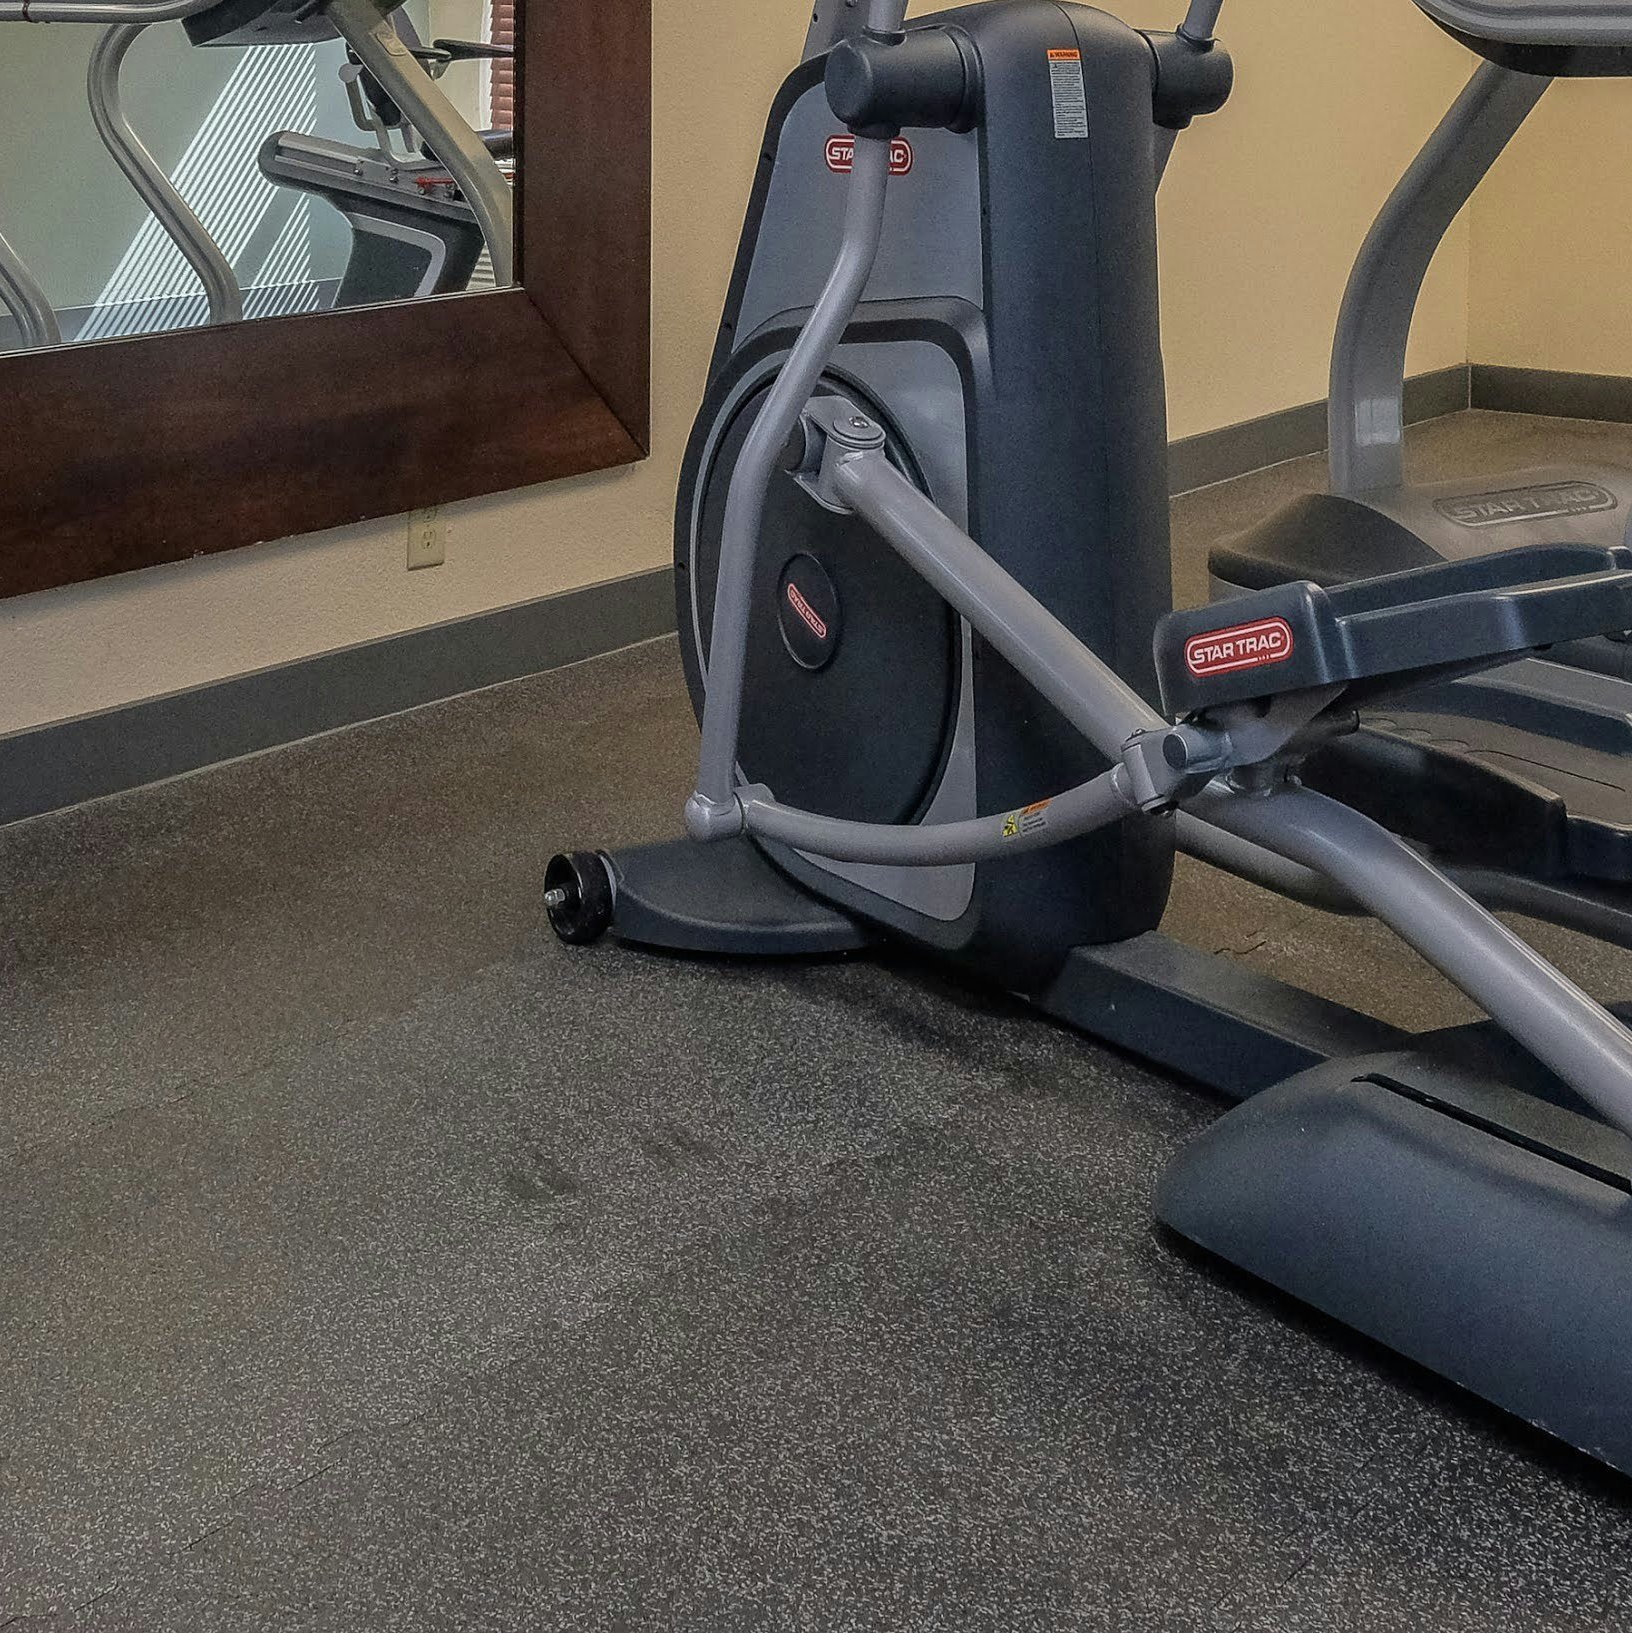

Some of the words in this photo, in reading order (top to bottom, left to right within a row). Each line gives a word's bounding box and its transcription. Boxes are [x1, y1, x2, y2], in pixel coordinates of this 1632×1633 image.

[829, 146, 855, 161] STA
[1193, 642, 1234, 664] STAR
[1236, 631, 1282, 655] TRAC
